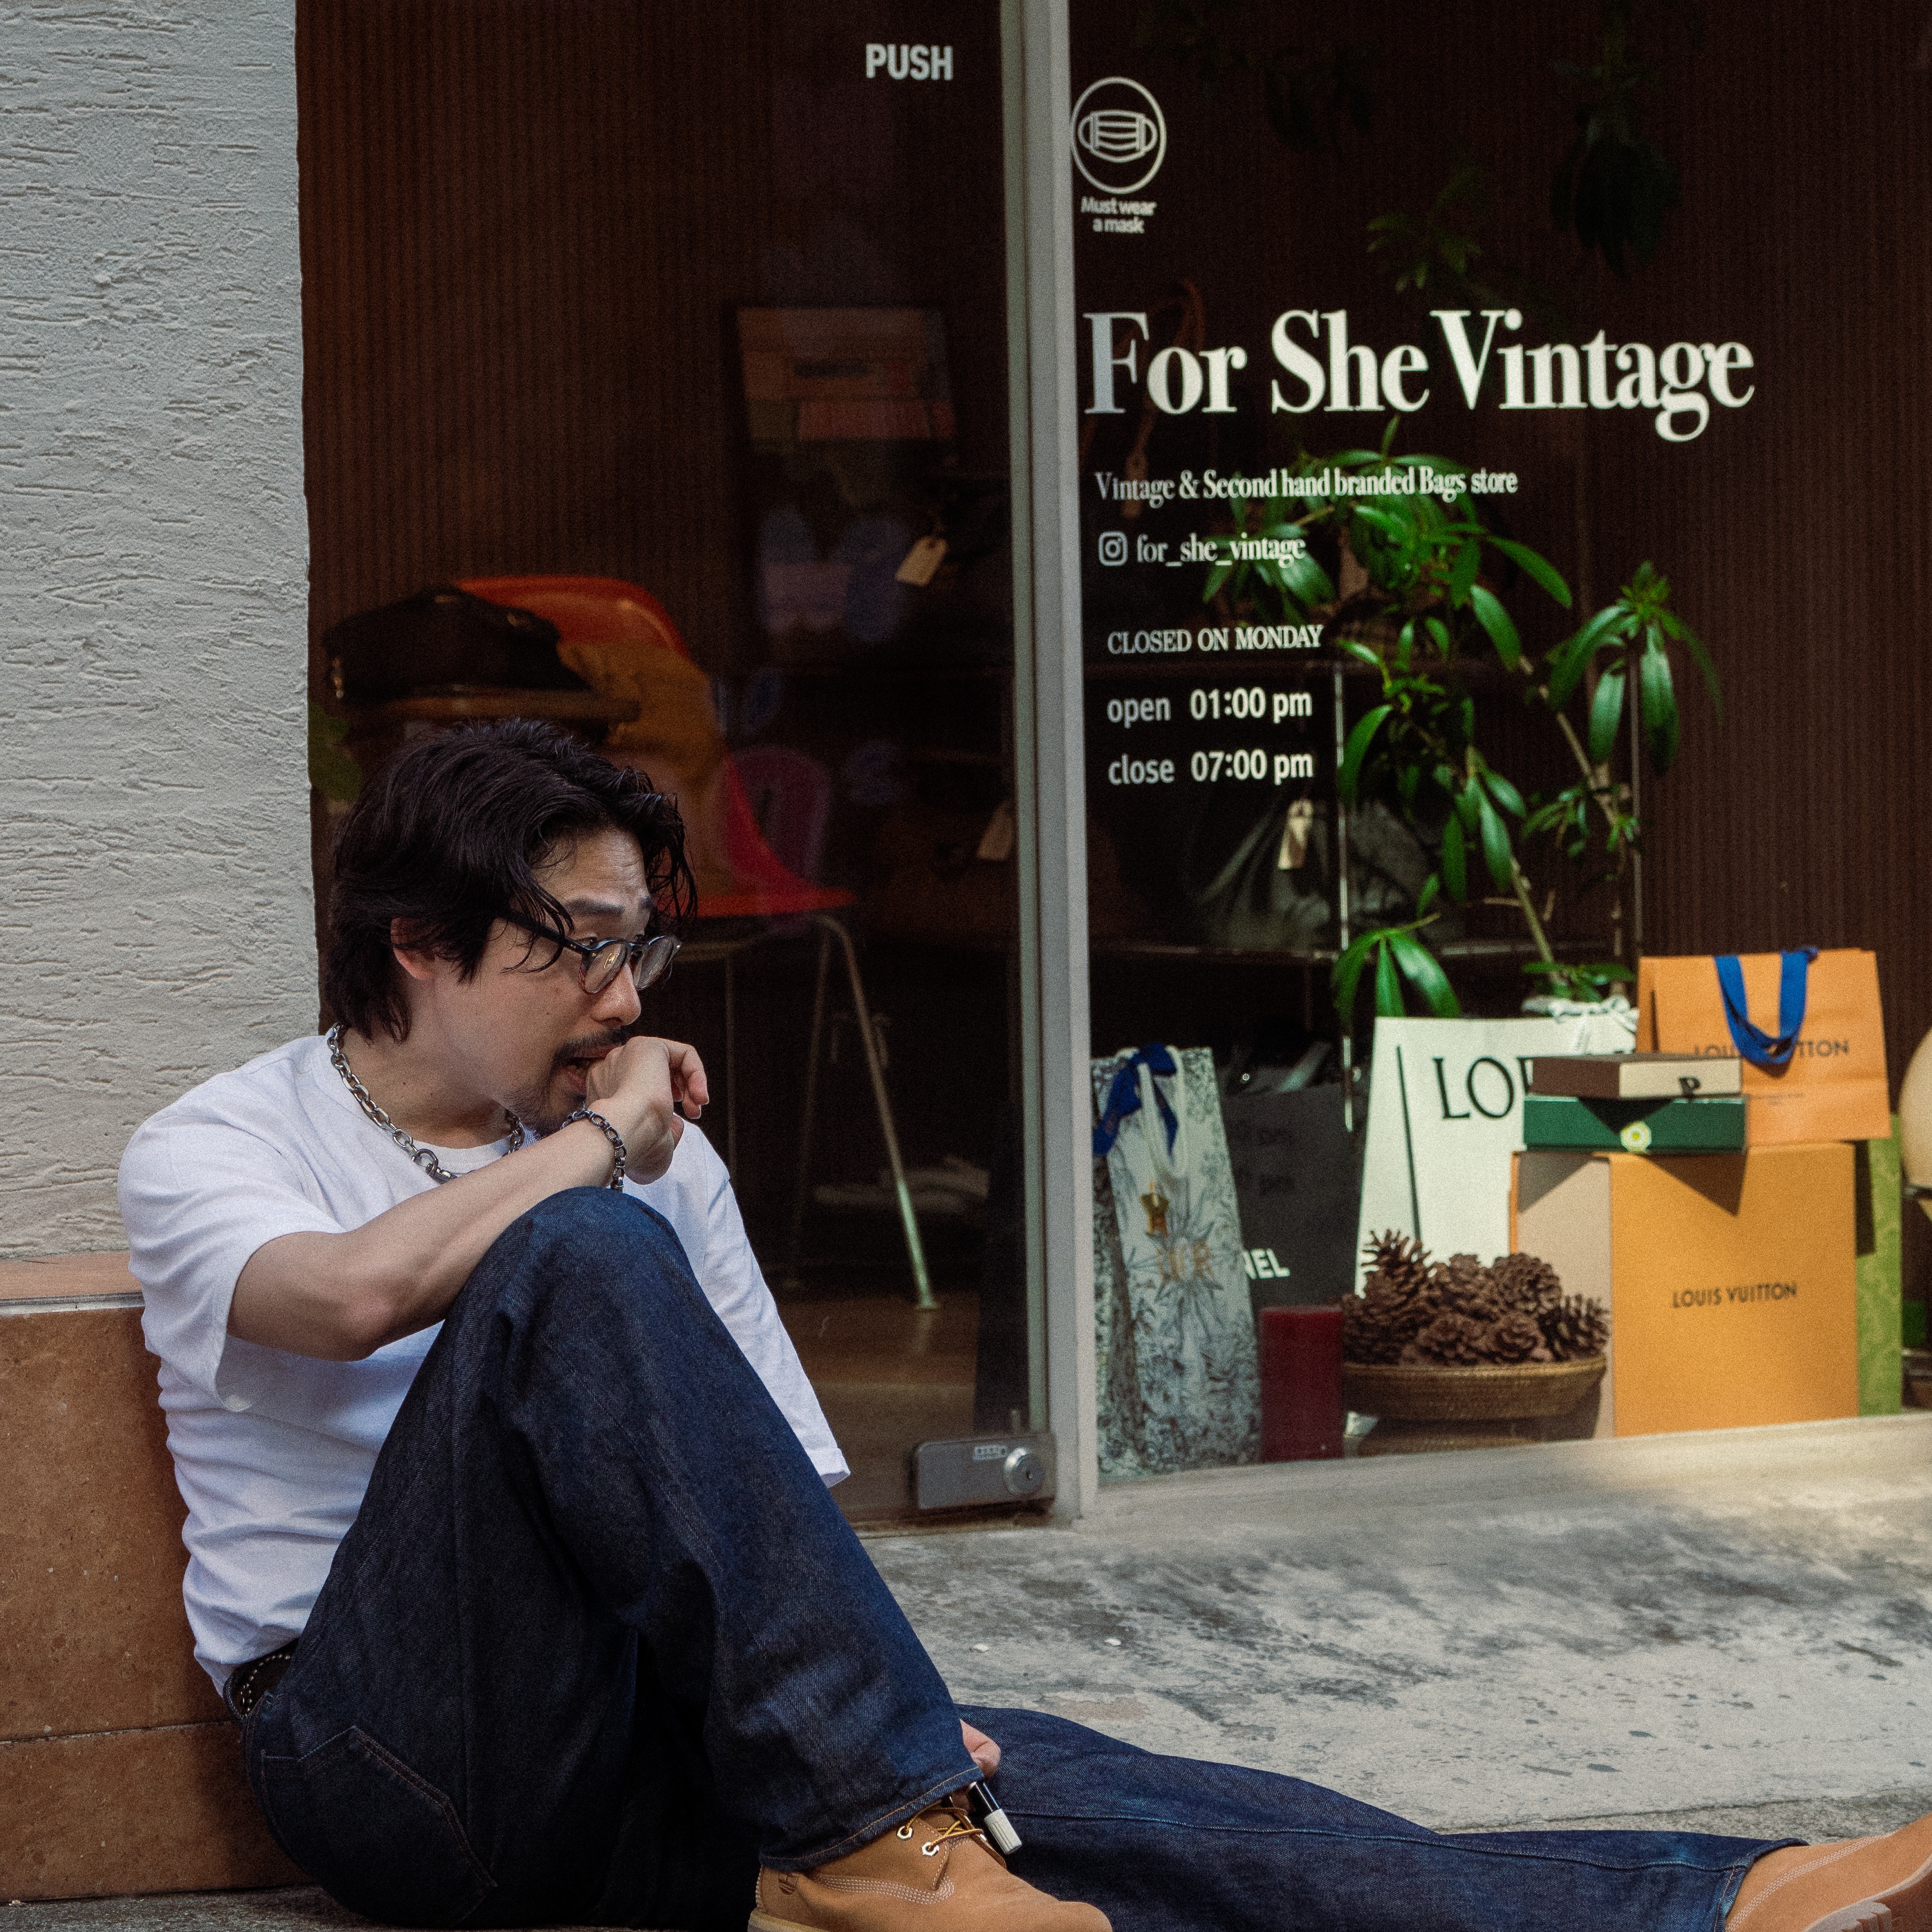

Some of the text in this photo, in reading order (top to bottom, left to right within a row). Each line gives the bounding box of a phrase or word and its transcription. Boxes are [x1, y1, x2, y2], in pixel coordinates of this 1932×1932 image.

[866, 44, 953, 80] PUSH
[1081, 196, 1157, 216] Must wear
[1093, 216, 1145, 233] a mask
[1083, 309, 1754, 442] For She Vintage
[1094, 465, 1518, 508] Vintage & Second hand branded Bags store
[1136, 531, 1306, 568] for_she_vintage
[1107, 624, 1324, 654] CLOSED ON MONDAY
[1107, 687, 1312, 728] open 01:00 pm
[1108, 749, 1313, 785] close 07:00 pm
[1671, 1281, 1797, 1308] LOUIS VUITTON
